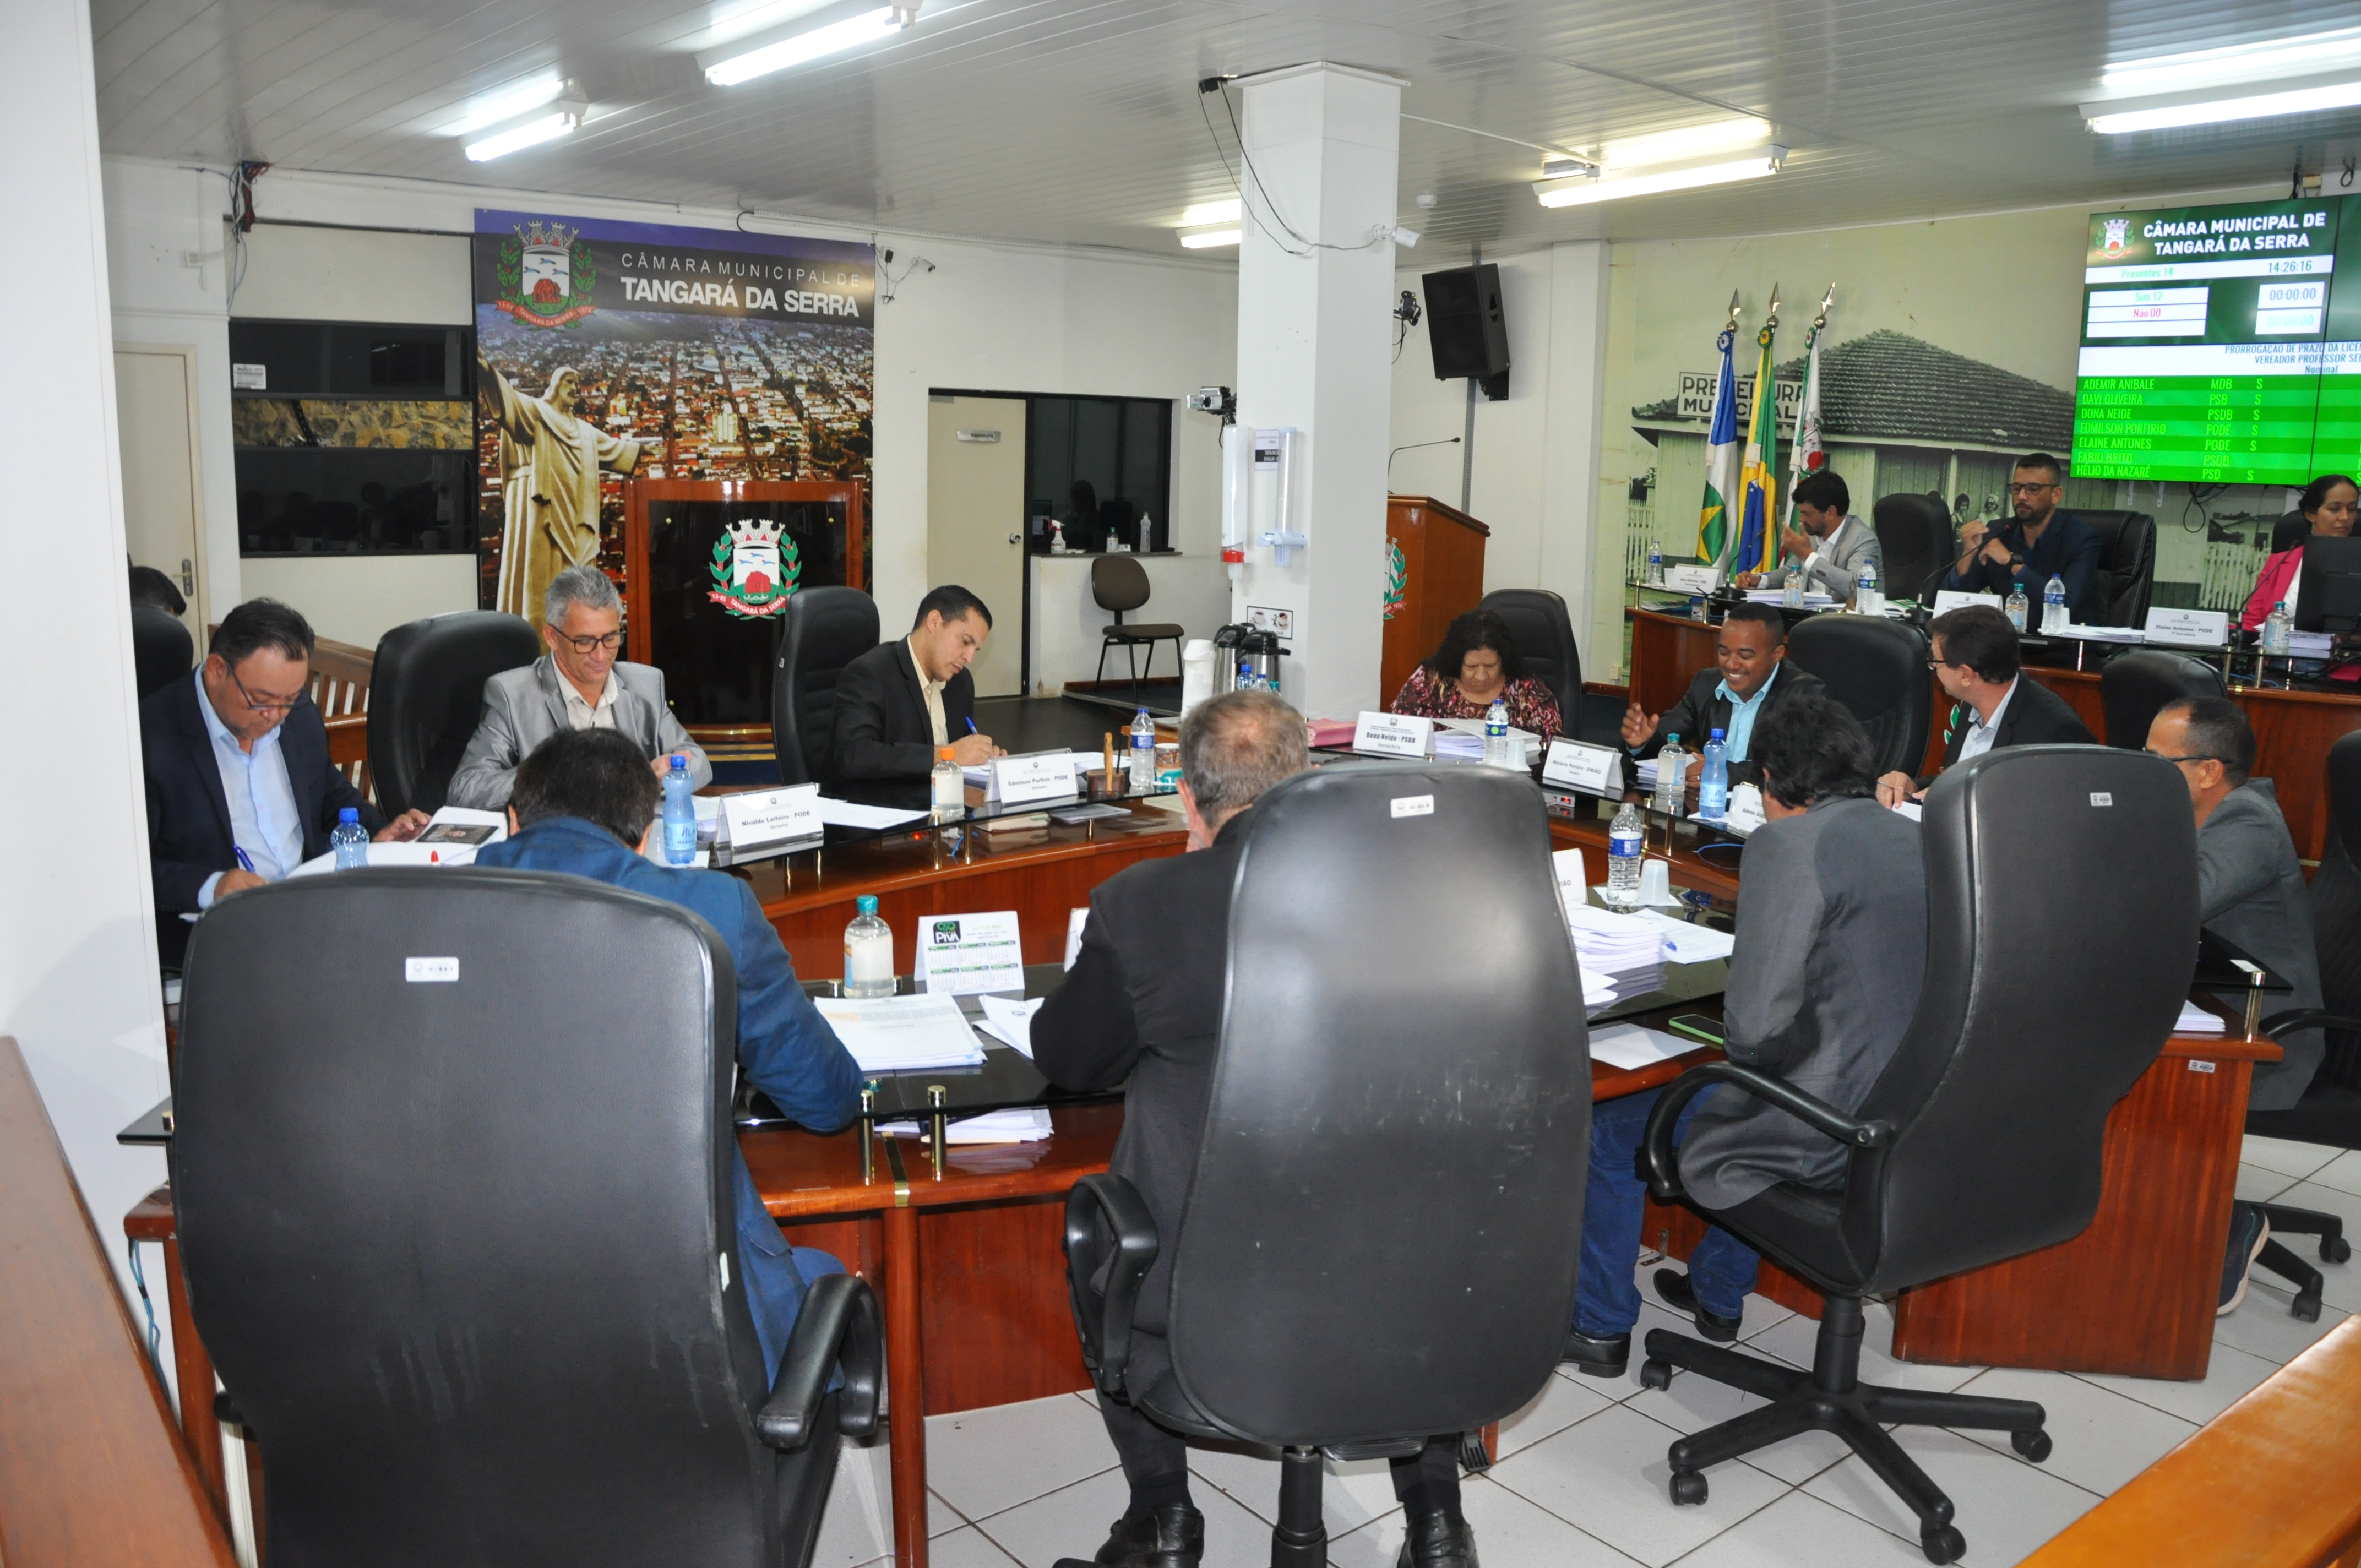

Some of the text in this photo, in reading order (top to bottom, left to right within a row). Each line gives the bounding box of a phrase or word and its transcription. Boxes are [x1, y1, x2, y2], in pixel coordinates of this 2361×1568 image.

[2143, 212, 2326, 237] CÂMARA MUNICIPAL DE
[2154, 233, 2310, 255] TANGARÁ DA SERRA
[621, 252, 859, 287] CÂMARA MUNICIPAL DE
[2121, 267, 2174, 278] Presentes 14
[2268, 260, 2313, 273] 14:26:16
[620, 277, 859, 318] TANGARÁ DA SERRA
[2135, 291, 2163, 302] Sim 12
[2270, 288, 2316, 301] 00:00:00
[2134, 308, 2161, 318] Não 00
[2286, 344, 2295, 352] DE
[2298, 343, 2324, 352] PRAZO
[2328, 343, 2339, 352] DA
[2255, 355, 2295, 364] VEREADOR
[2298, 354, 2346, 363] PROFESSOR
[2304, 365, 2338, 374] Nominal
[2083, 378, 2263, 390] ADEMIR ANIBALE MDB S
[2082, 393, 2261, 405] DAVI OLIVEIRA PSB S
[2081, 408, 2260, 420] DONA NEIDE PSDB S
[2080, 422, 2123, 434] EDMILSON
[2207, 424, 2231, 435] PODE
[2251, 424, 2258, 435] S
[2079, 437, 2257, 451] ELAINE ANTUNES PODE S
[2107, 452, 2133, 463] BRITO
[2204, 455, 2229, 466] PSDB
[2077, 462, 2101, 476] HÉLIO
[2103, 465, 2115, 476] DA
[2117, 464, 2151, 477] NAZARÉ
[2202, 468, 2221, 480] PSD
[2247, 470, 2254, 481] S
[769, 596, 786, 611] SERRA
[742, 818, 765, 826] Nivaldo
[766, 814, 790, 823] Leiteiro
